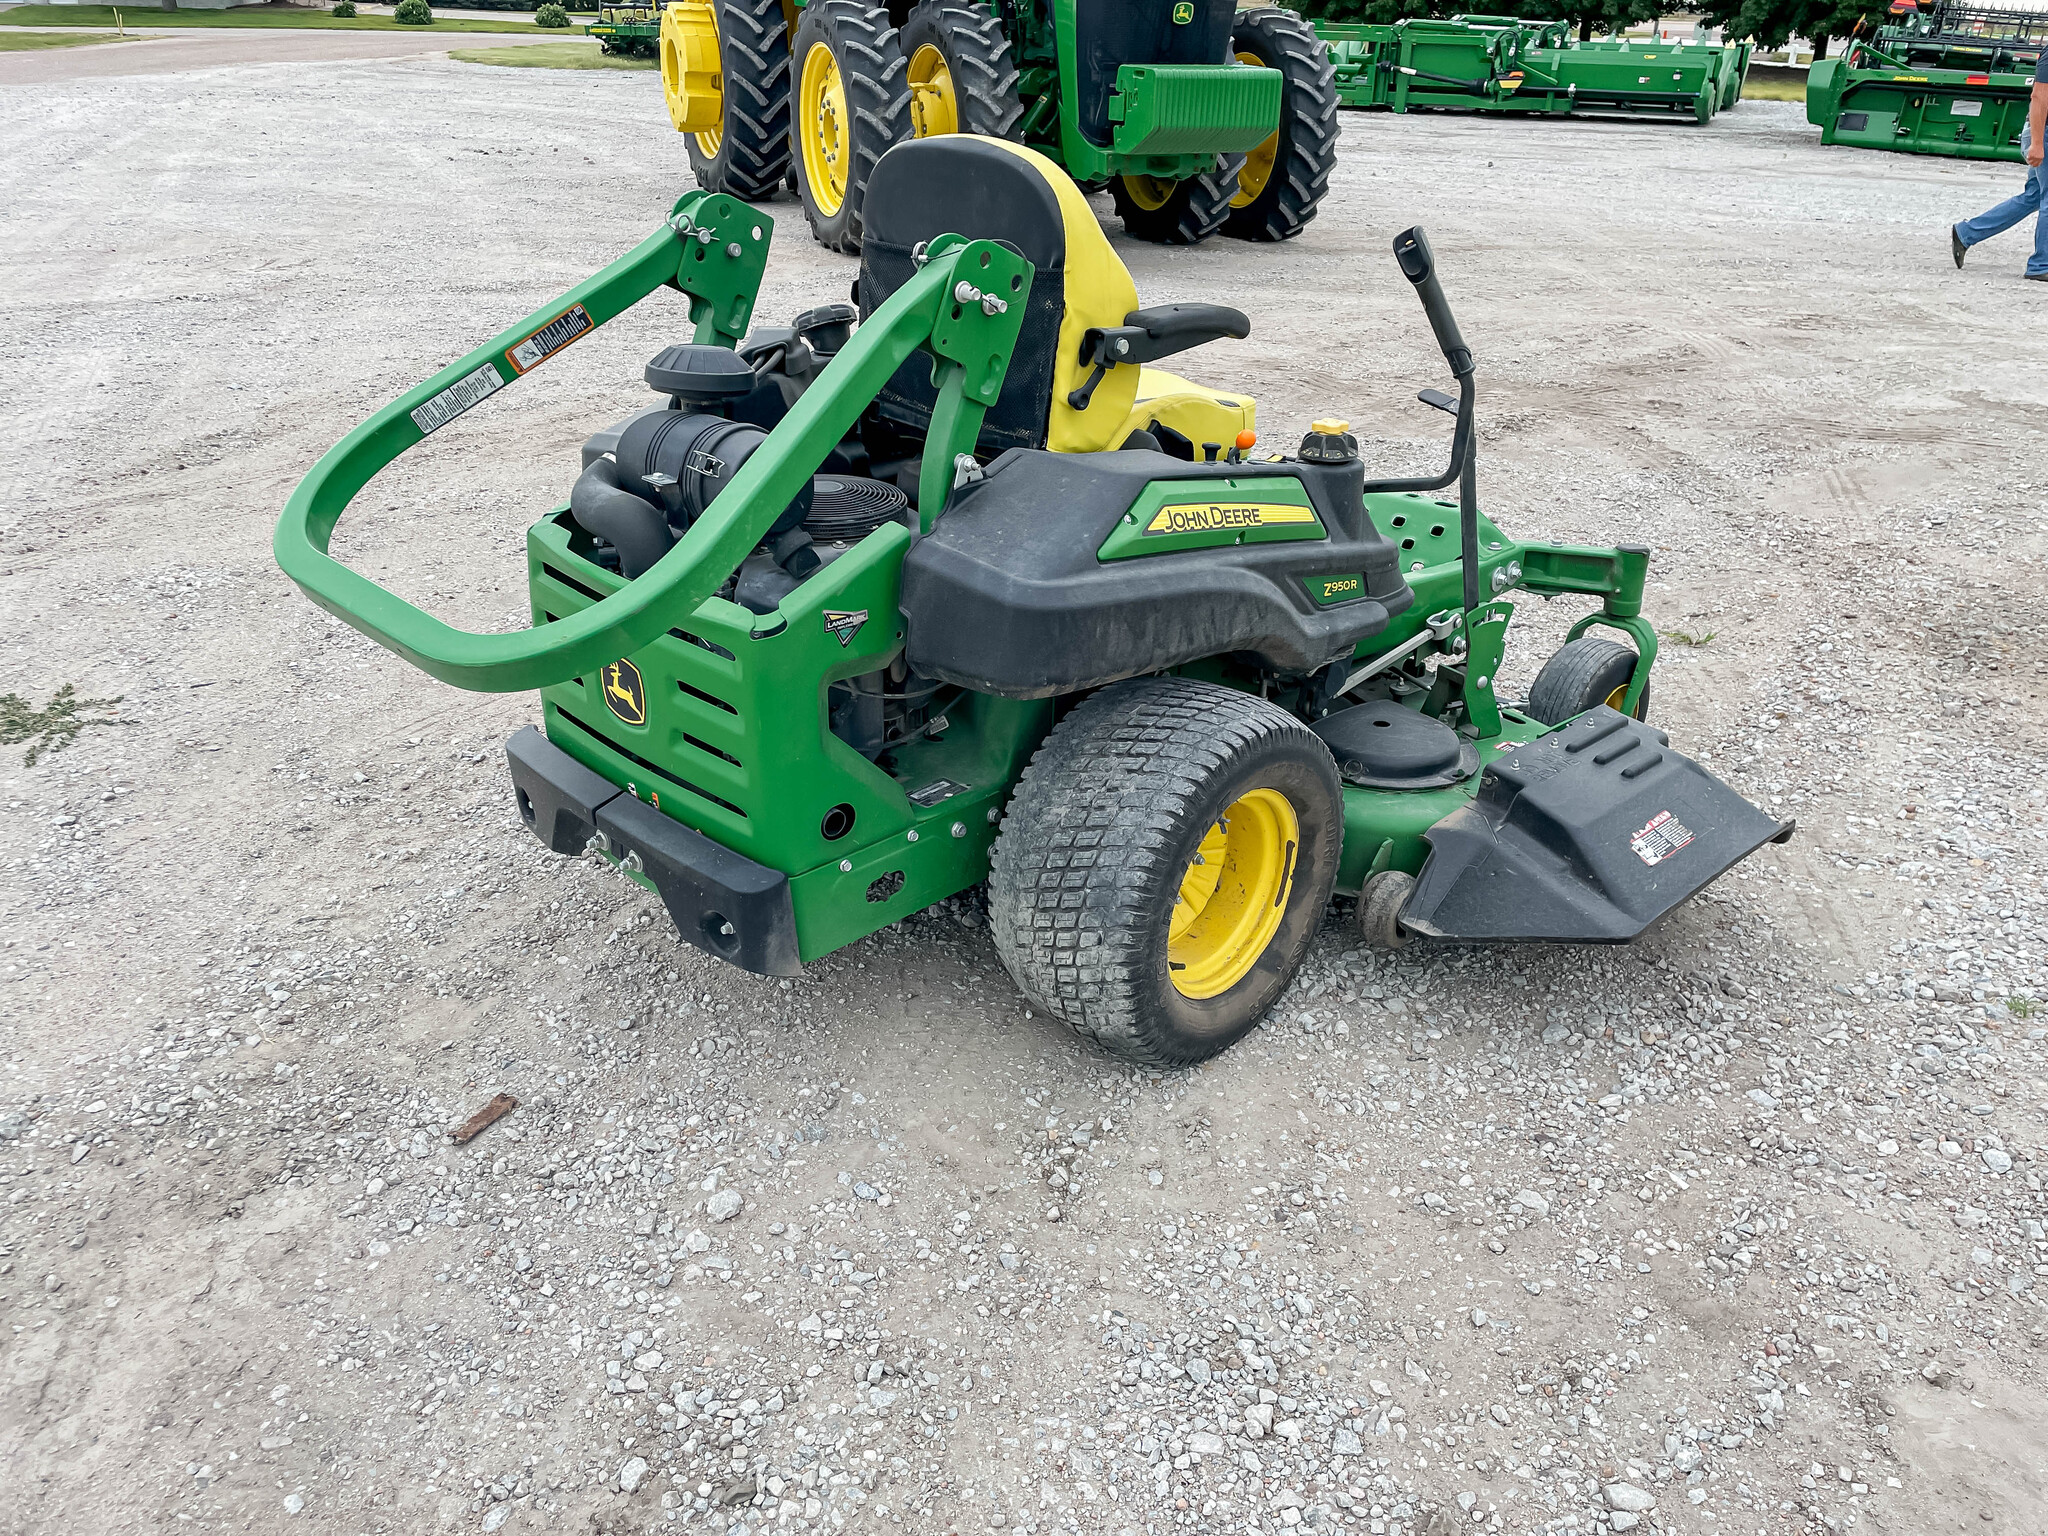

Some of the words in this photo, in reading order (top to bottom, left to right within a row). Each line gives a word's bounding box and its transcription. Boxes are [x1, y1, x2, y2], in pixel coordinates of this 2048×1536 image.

[1166, 509, 1210, 530] JOHN
[1210, 506, 1262, 526] DEERE
[1323, 579, 1358, 597] Z950R
